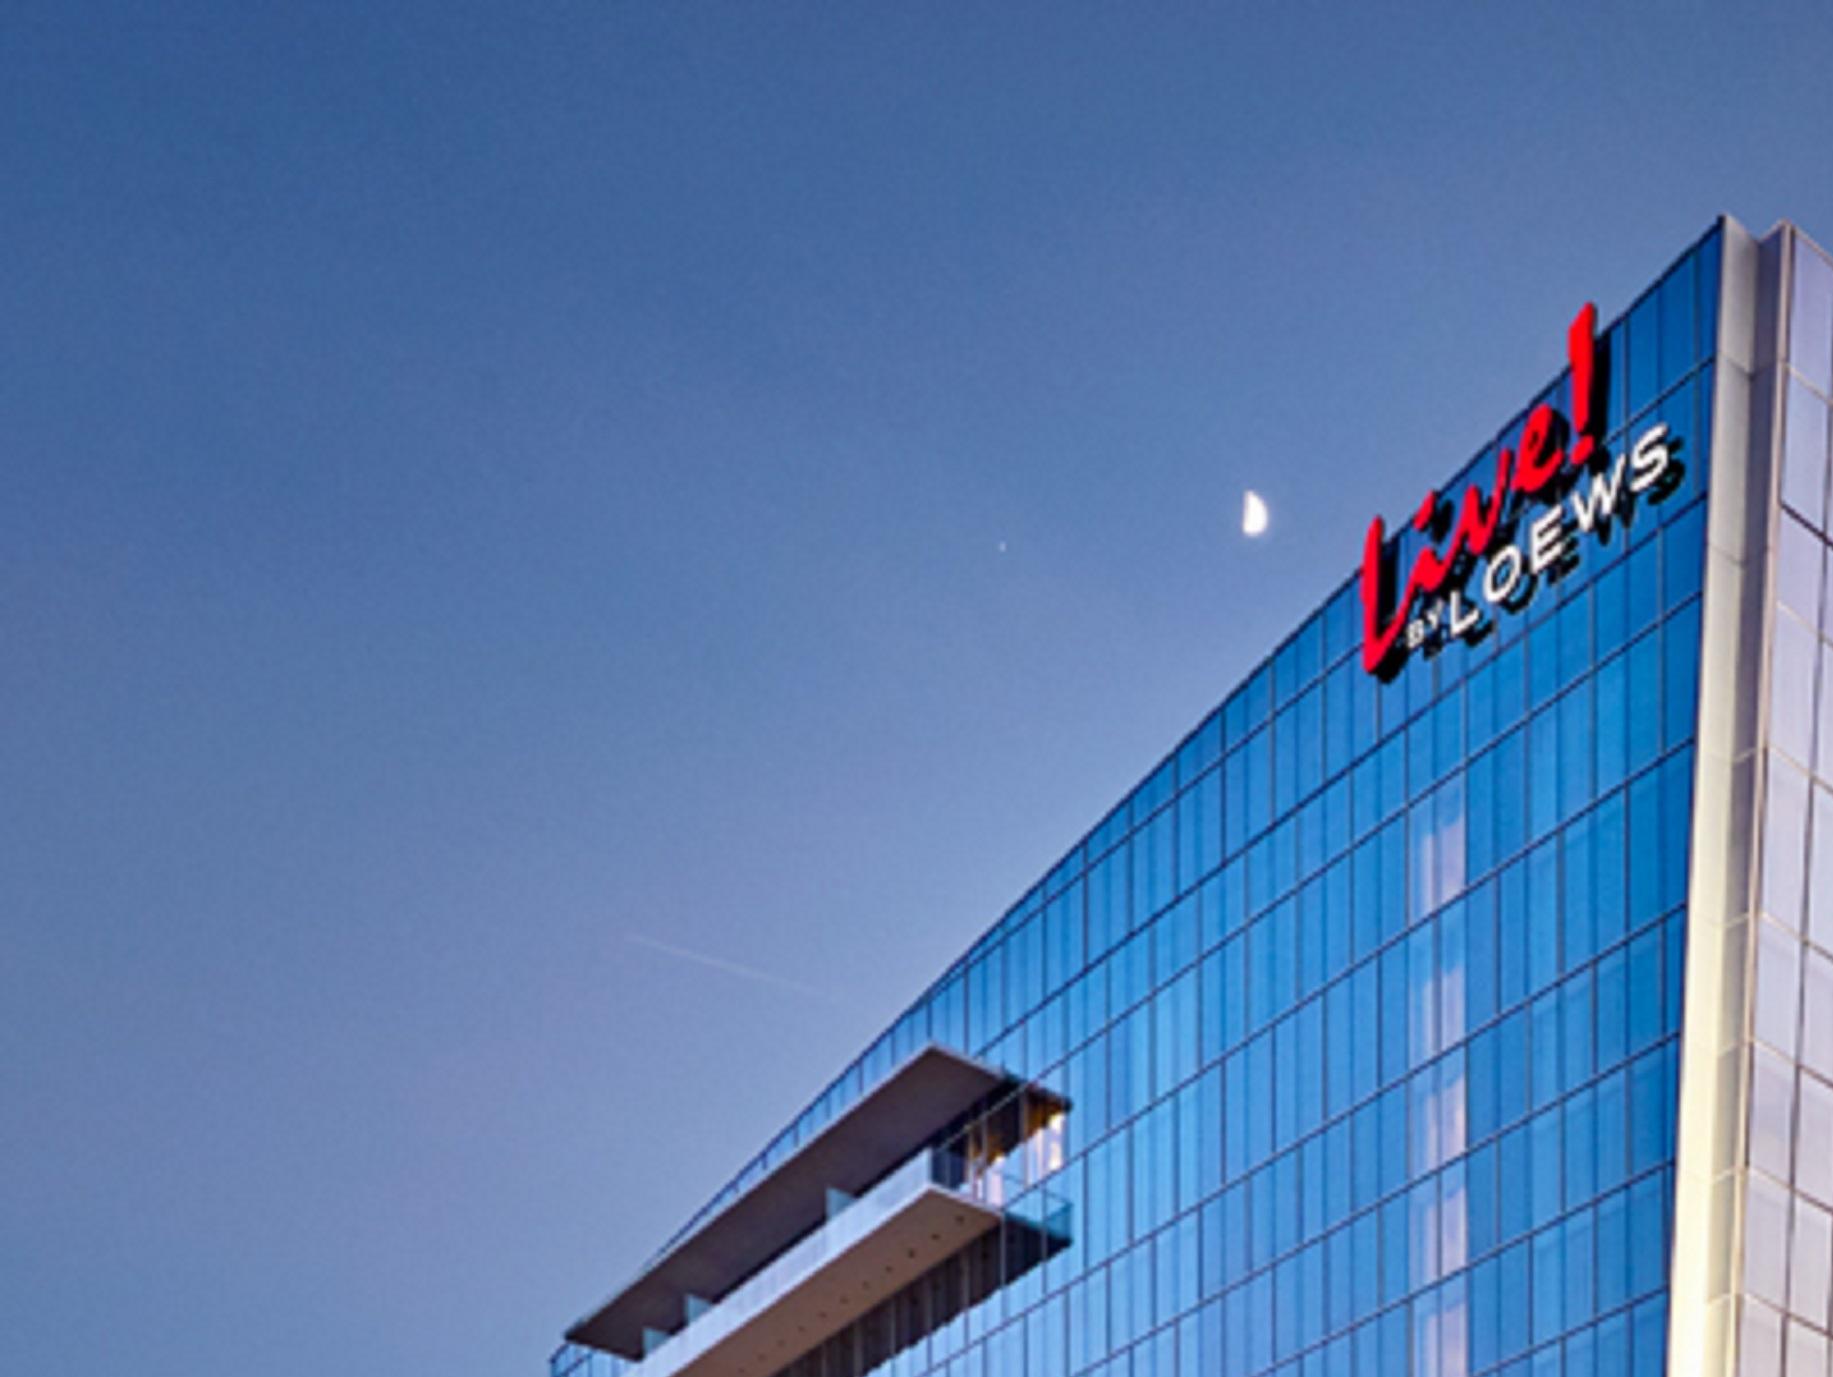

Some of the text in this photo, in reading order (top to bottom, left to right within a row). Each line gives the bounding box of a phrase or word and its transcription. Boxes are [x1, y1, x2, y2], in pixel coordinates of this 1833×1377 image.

[1360, 301, 1596, 674] Live!
[1405, 422, 1670, 650] BY LOEWS
